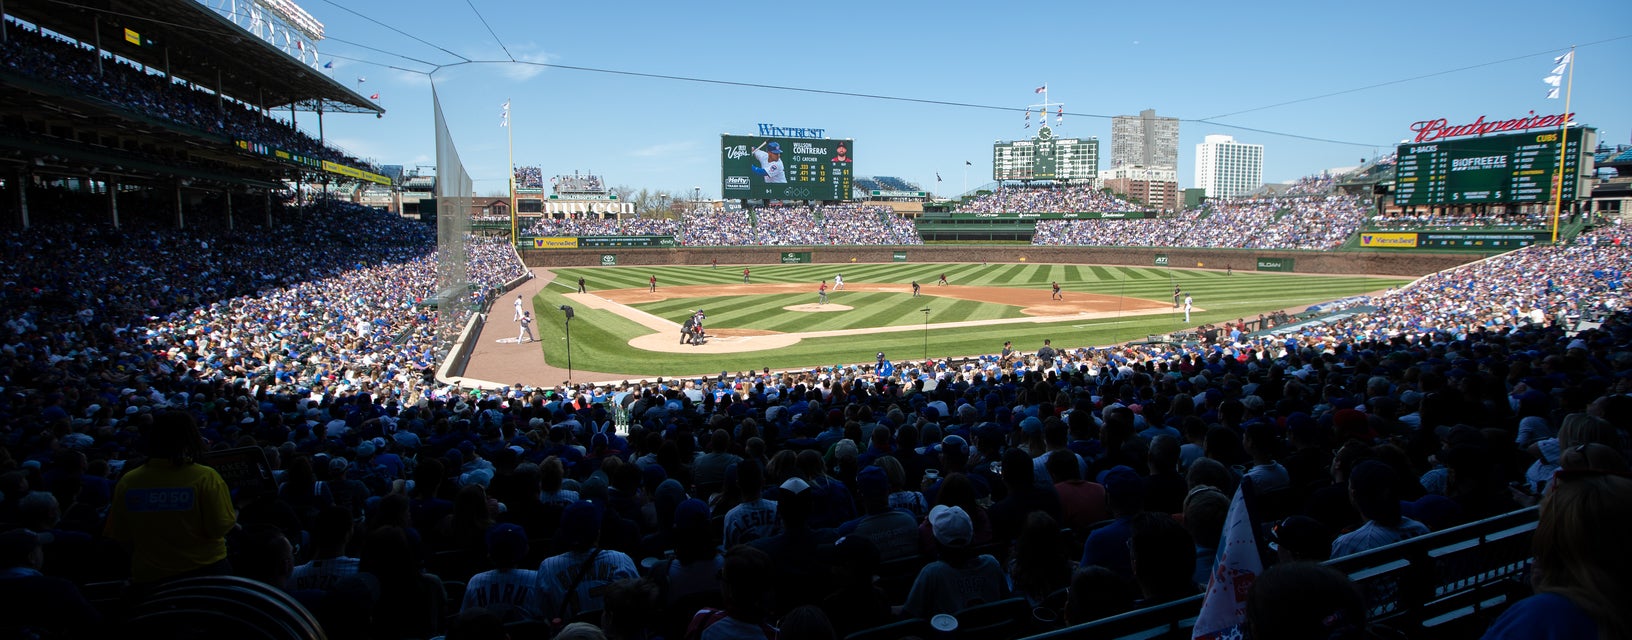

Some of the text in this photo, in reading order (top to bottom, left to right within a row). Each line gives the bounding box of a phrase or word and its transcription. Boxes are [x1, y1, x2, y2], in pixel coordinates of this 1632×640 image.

[758, 123, 825, 139] WINTRUST
[1410, 110, 1575, 142] Budweiser
[1536, 133, 1558, 143] CUBS
[724, 145, 750, 160] Vegas
[793, 147, 827, 155] CONTRERAS
[1410, 145, 1438, 154] D-BACKS
[728, 176, 748, 184] Hefty
[544, 202, 635, 215] nuveen
